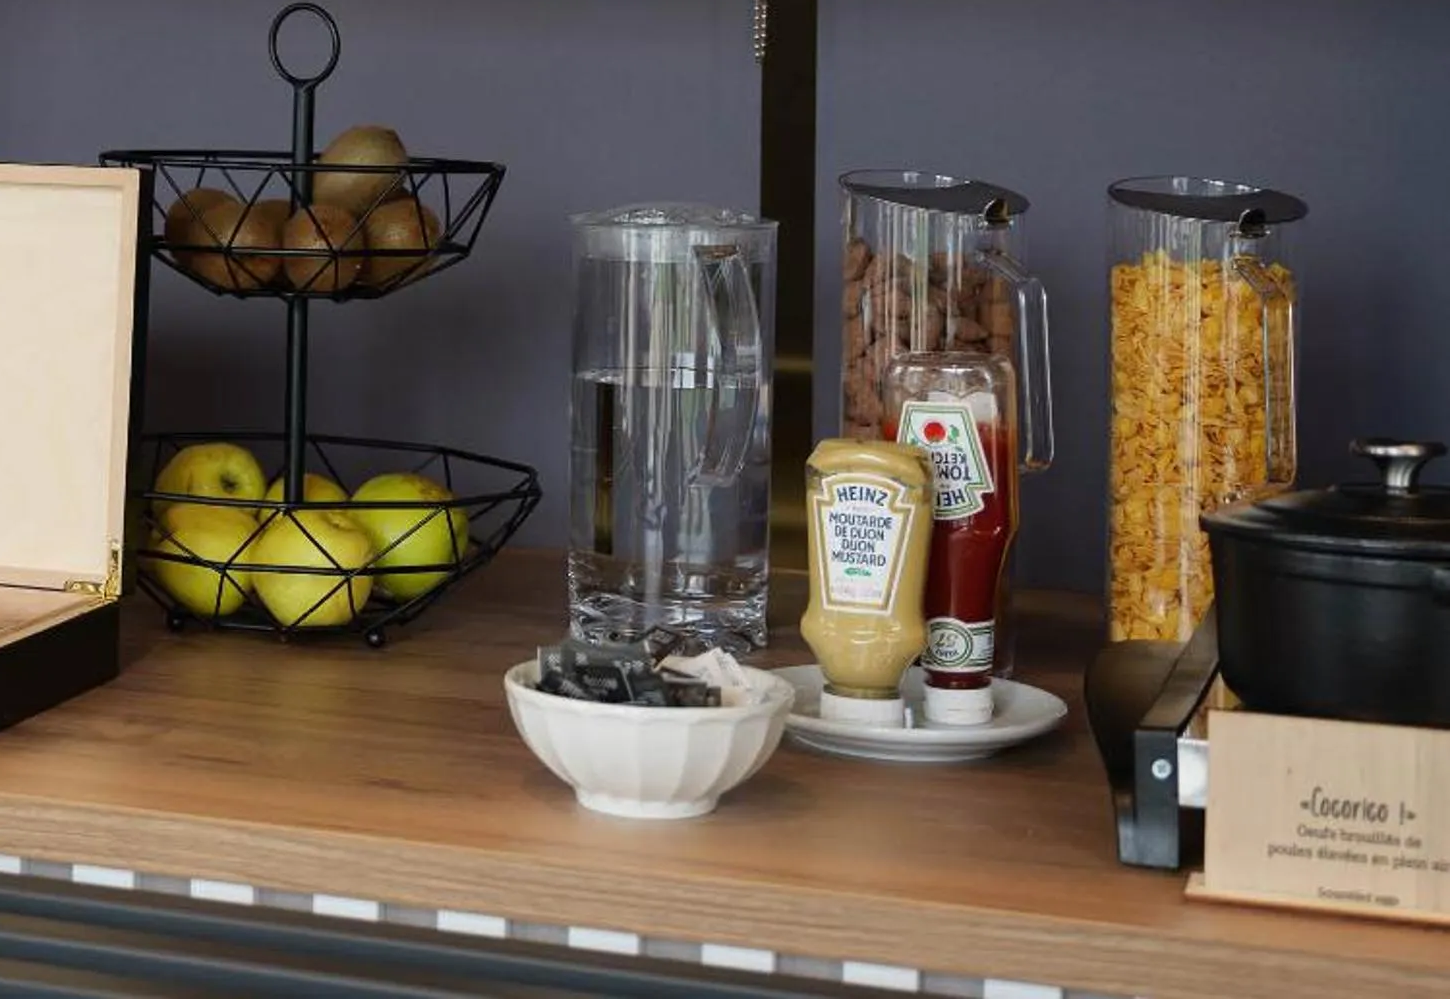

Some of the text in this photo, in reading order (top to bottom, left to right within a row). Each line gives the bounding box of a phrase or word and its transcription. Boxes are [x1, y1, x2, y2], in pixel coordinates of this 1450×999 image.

[931, 451, 967, 464] KETC
[936, 465, 972, 481] TOM
[836, 485, 888, 507] HEINZ
[936, 488, 966, 506] HEI
[829, 511, 893, 530] MOUTARDE
[834, 525, 848, 538] DE
[832, 551, 886, 567] MUSTARD
[1404, 836, 1422, 849] de
[1267, 843, 1313, 859] poules
[1372, 854, 1389, 865] en
